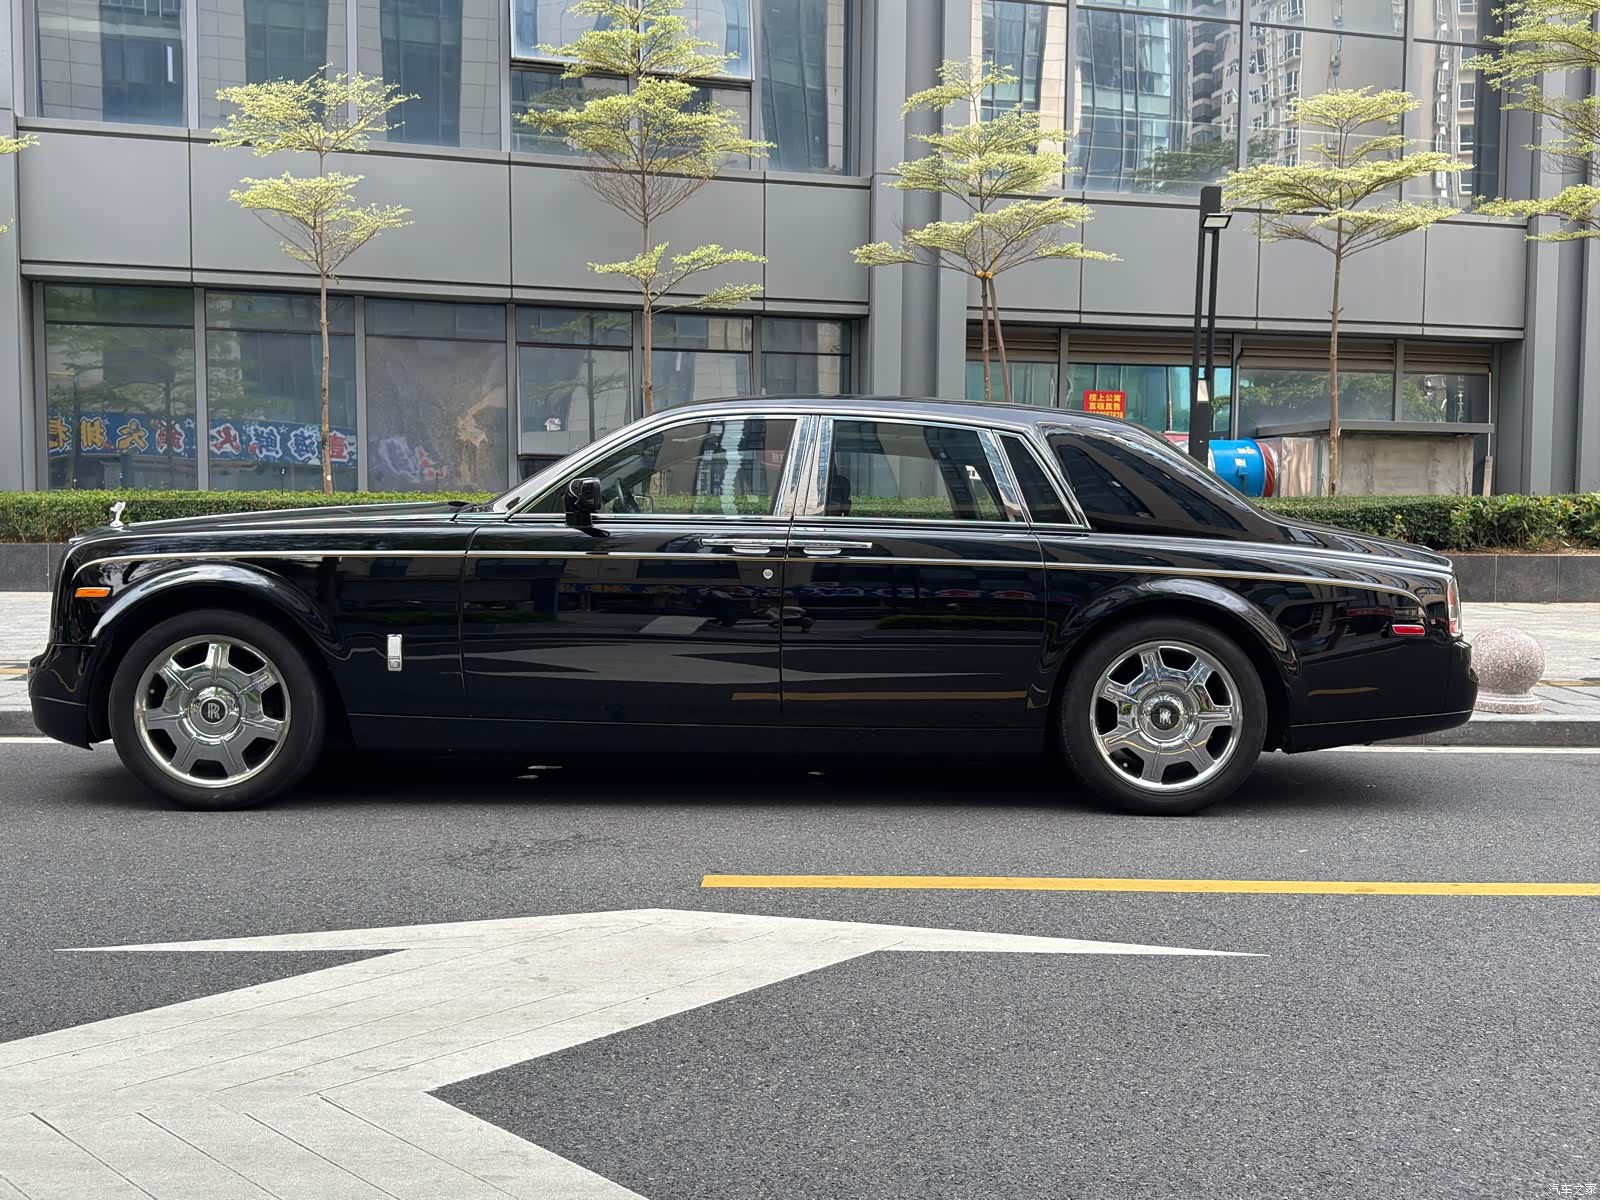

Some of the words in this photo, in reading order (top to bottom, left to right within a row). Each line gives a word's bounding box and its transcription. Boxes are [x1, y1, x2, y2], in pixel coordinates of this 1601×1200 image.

[1088, 393, 1122, 402] 楼上公寓
[207, 702, 221, 720] RR
